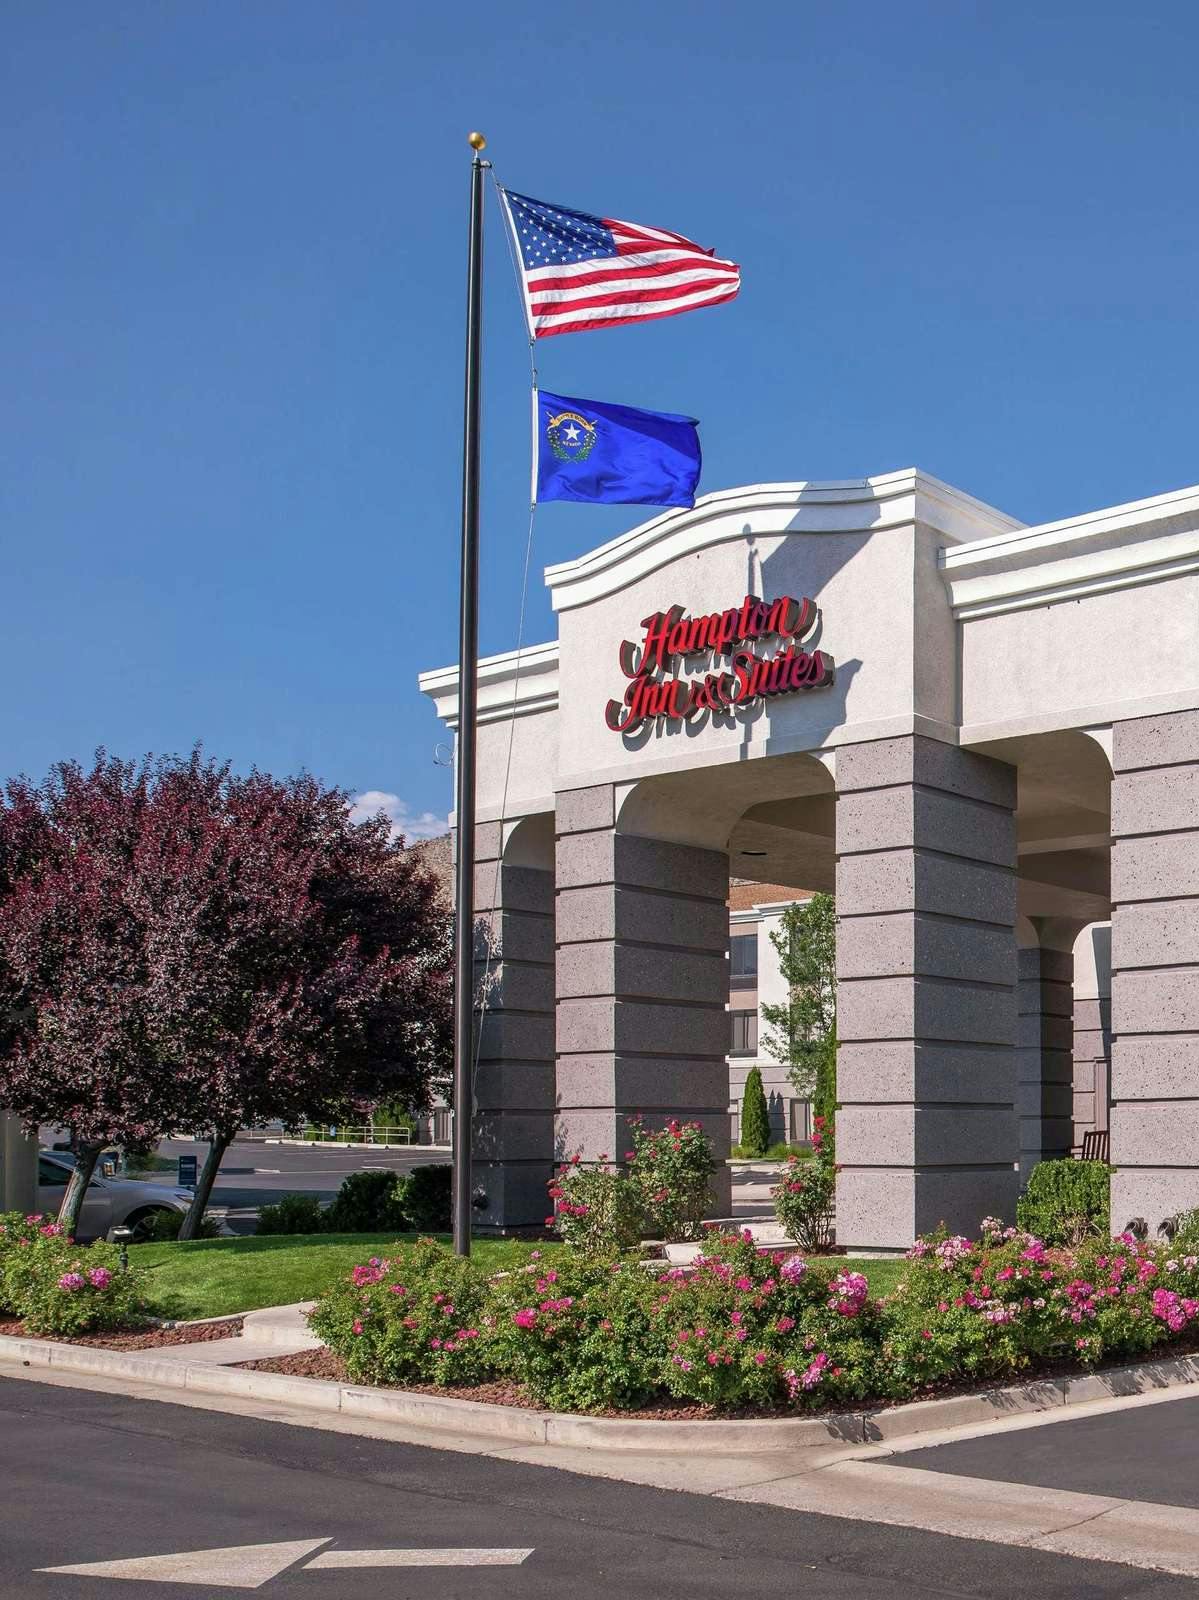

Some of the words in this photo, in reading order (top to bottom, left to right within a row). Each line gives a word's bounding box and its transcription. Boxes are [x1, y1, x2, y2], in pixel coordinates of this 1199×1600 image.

[619, 594, 816, 679] Hampton
[605, 674, 696, 732] Inn
[695, 673, 720, 711] &
[717, 644, 834, 704] Suites
